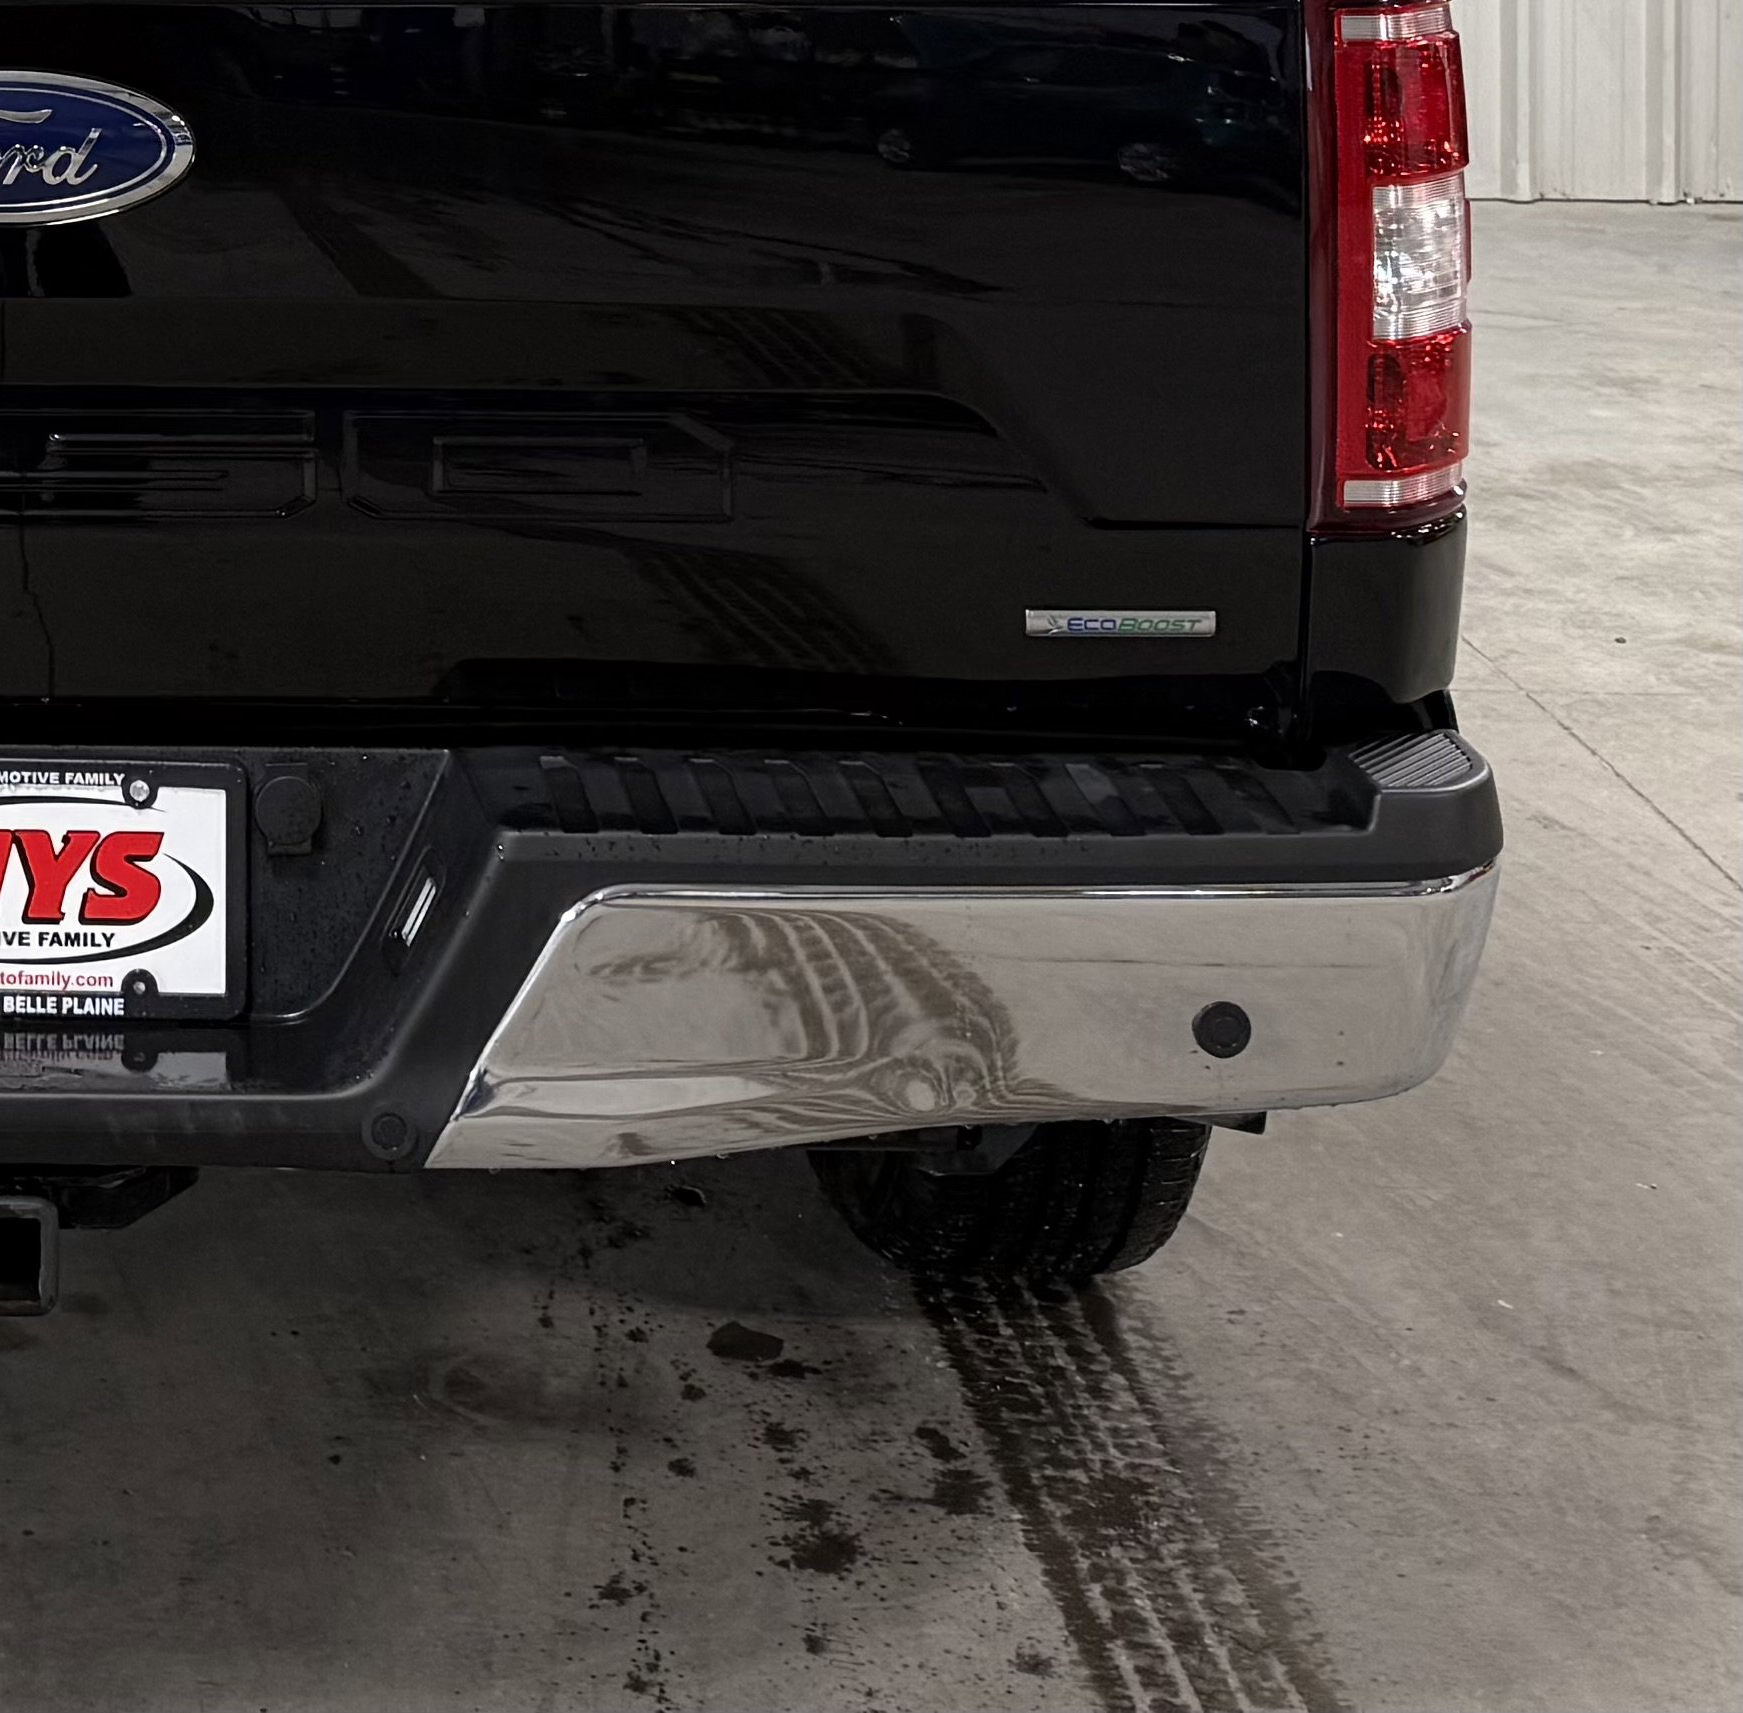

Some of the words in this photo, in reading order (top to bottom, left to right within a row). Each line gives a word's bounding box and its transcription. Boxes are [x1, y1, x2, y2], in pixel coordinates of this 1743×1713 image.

[64, 772, 125, 786] FAMILY
[38, 931, 116, 948] FAMILY
[3, 995, 58, 1014] BELLE
[61, 997, 125, 1016] PLAINE
